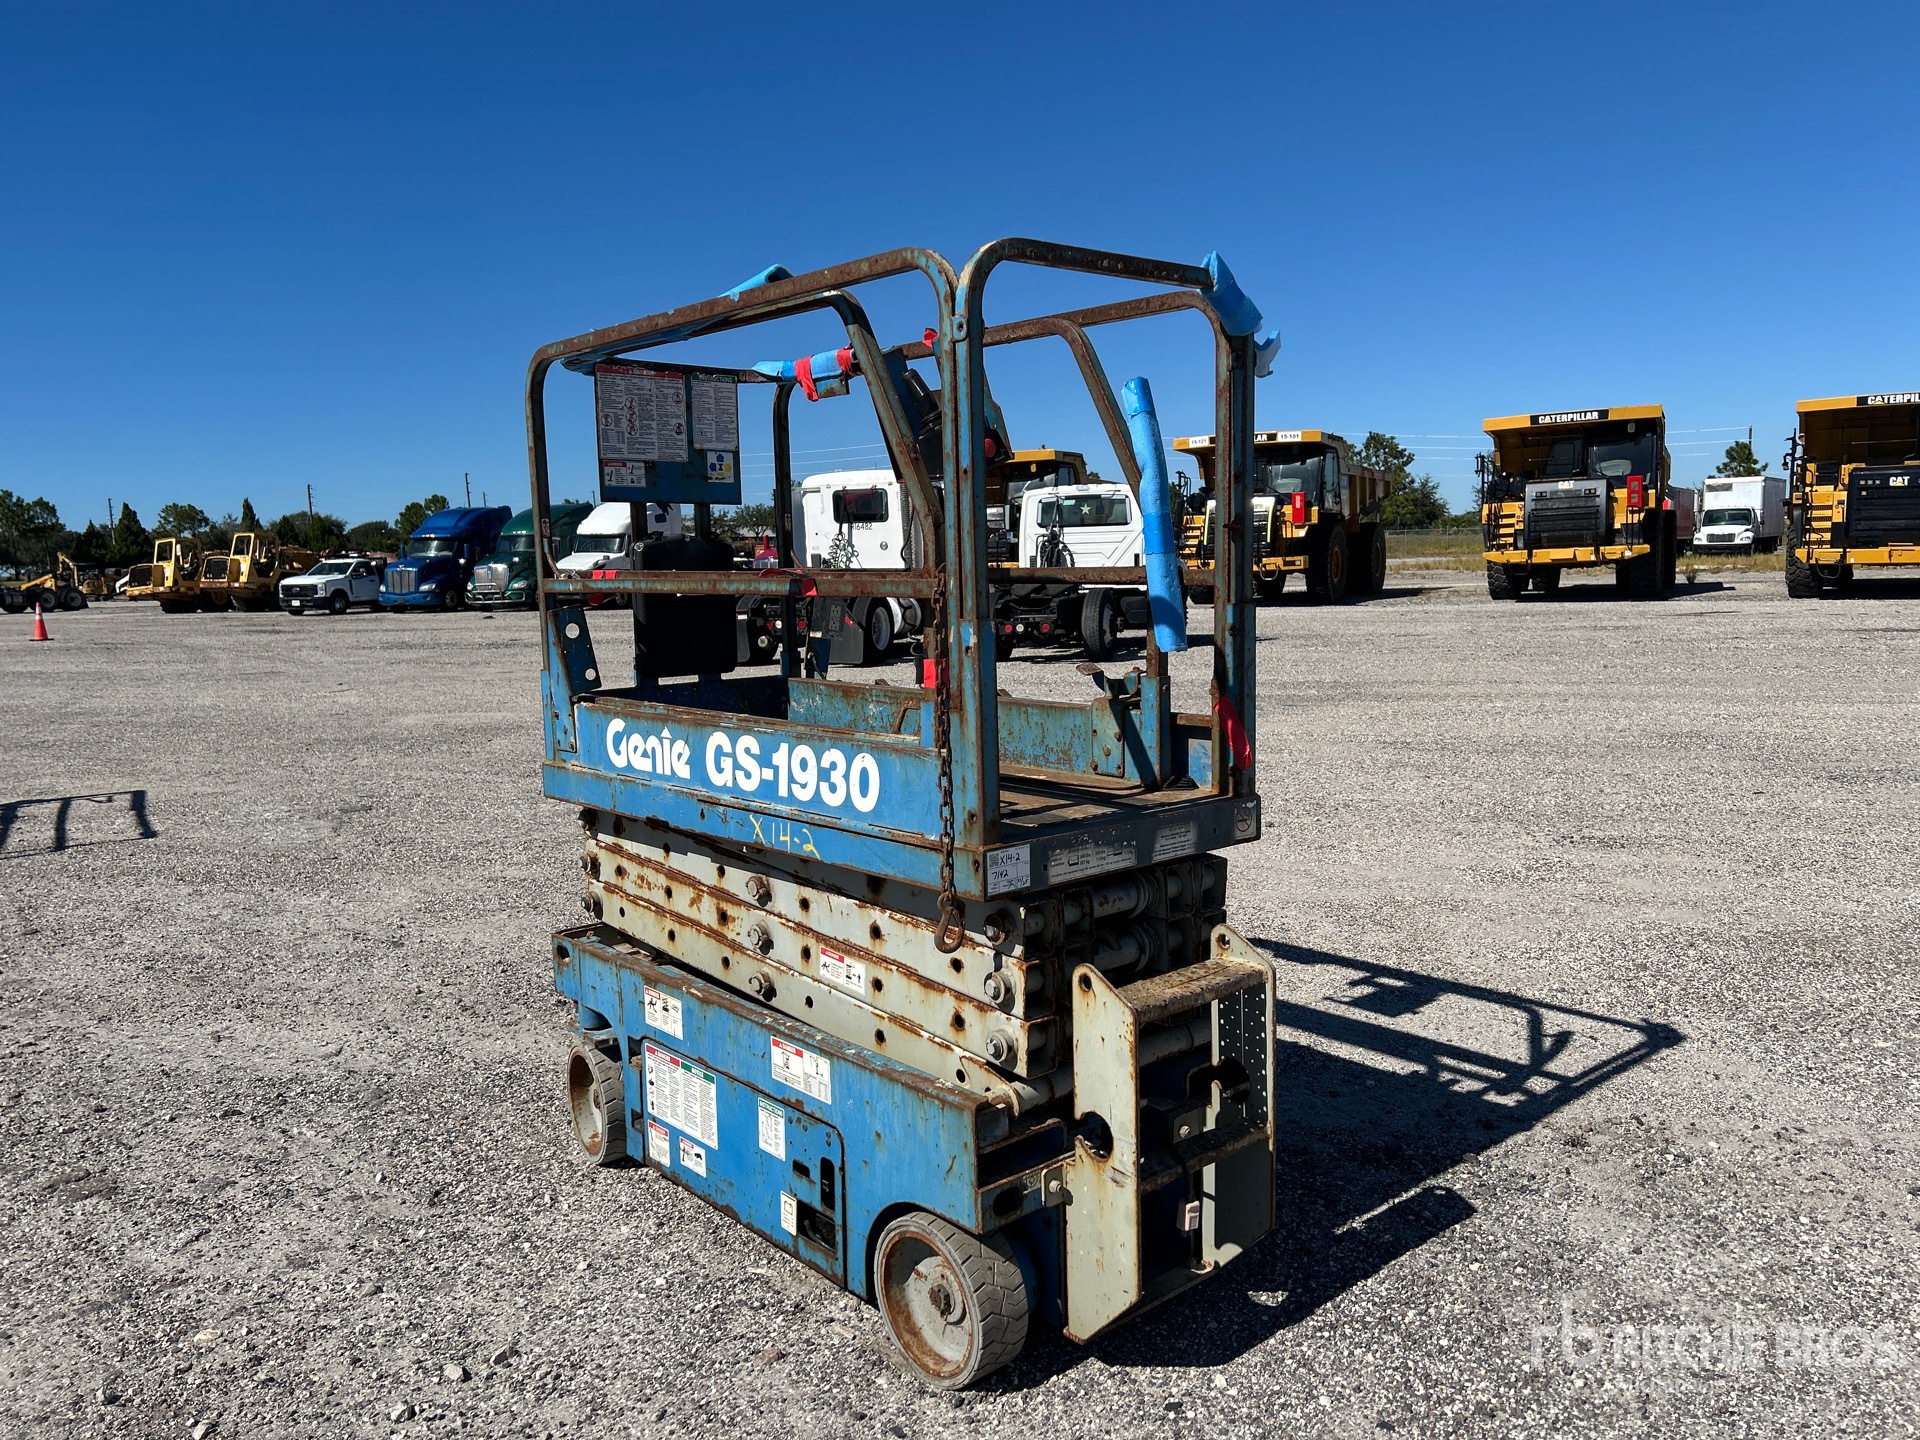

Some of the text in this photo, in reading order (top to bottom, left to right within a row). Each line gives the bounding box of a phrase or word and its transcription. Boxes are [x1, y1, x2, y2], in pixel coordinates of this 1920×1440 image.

[1538, 411, 1599, 424] CATERPILLAR
[1557, 480, 1575, 489] CAT
[1889, 476, 1911, 487] CAT
[606, 718, 881, 813] Genie GS-1930
[749, 813, 822, 861] X14-2
[999, 852, 1021, 866] X14-2
